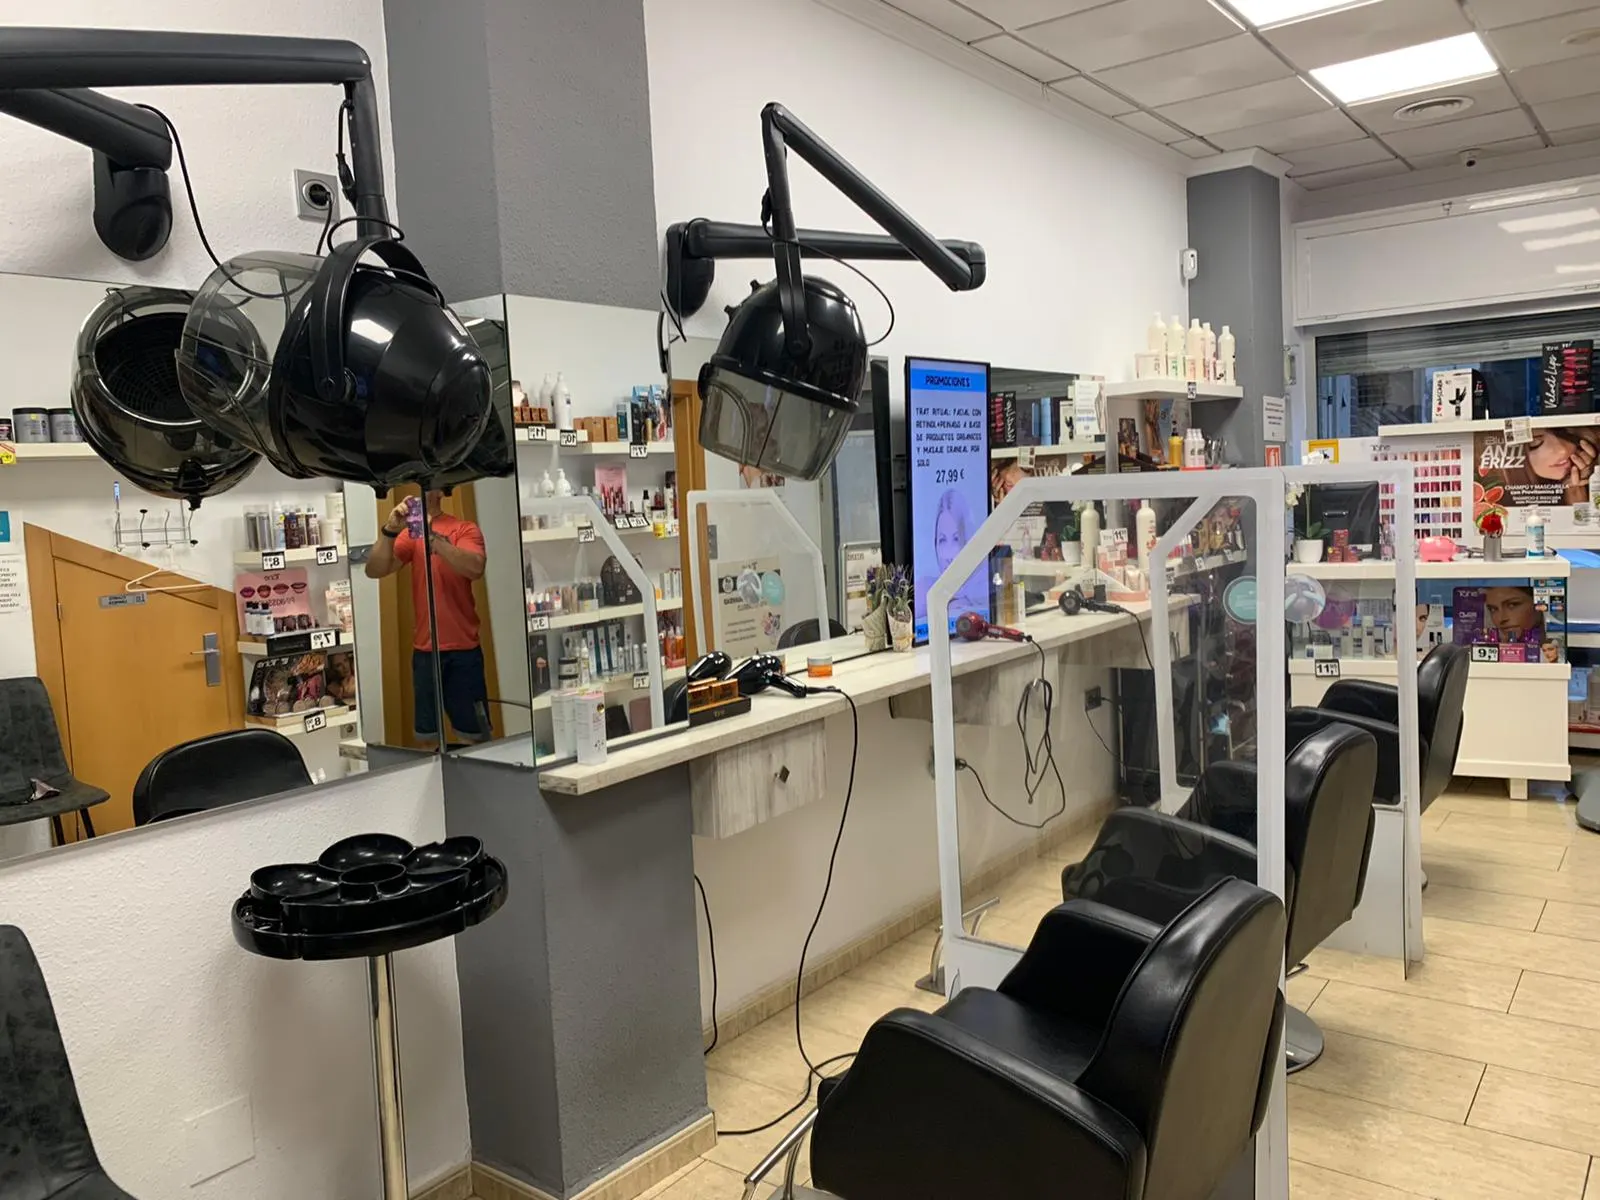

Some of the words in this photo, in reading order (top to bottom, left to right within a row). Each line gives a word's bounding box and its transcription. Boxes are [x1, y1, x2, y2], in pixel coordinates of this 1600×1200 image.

[1543, 354, 1562, 375] Lips
[925, 375, 971, 388] PROMOCIONES
[1543, 375, 1558, 409] Velvet
[953, 408, 970, 417] FACIAL
[972, 408, 982, 417] CON
[916, 433, 923, 442] DE
[926, 433, 954, 442] PRODUCTOS
[923, 446, 944, 454] MASAJE
[947, 445, 968, 454] CRANEAL
[971, 445, 980, 453] POR
[1480, 444, 1524, 458] ANTI
[917, 459, 930, 467] SOLO
[1480, 456, 1526, 469] FRIZZ
[936, 469, 958, 485] 27,99
[960, 468, 965, 479] €
